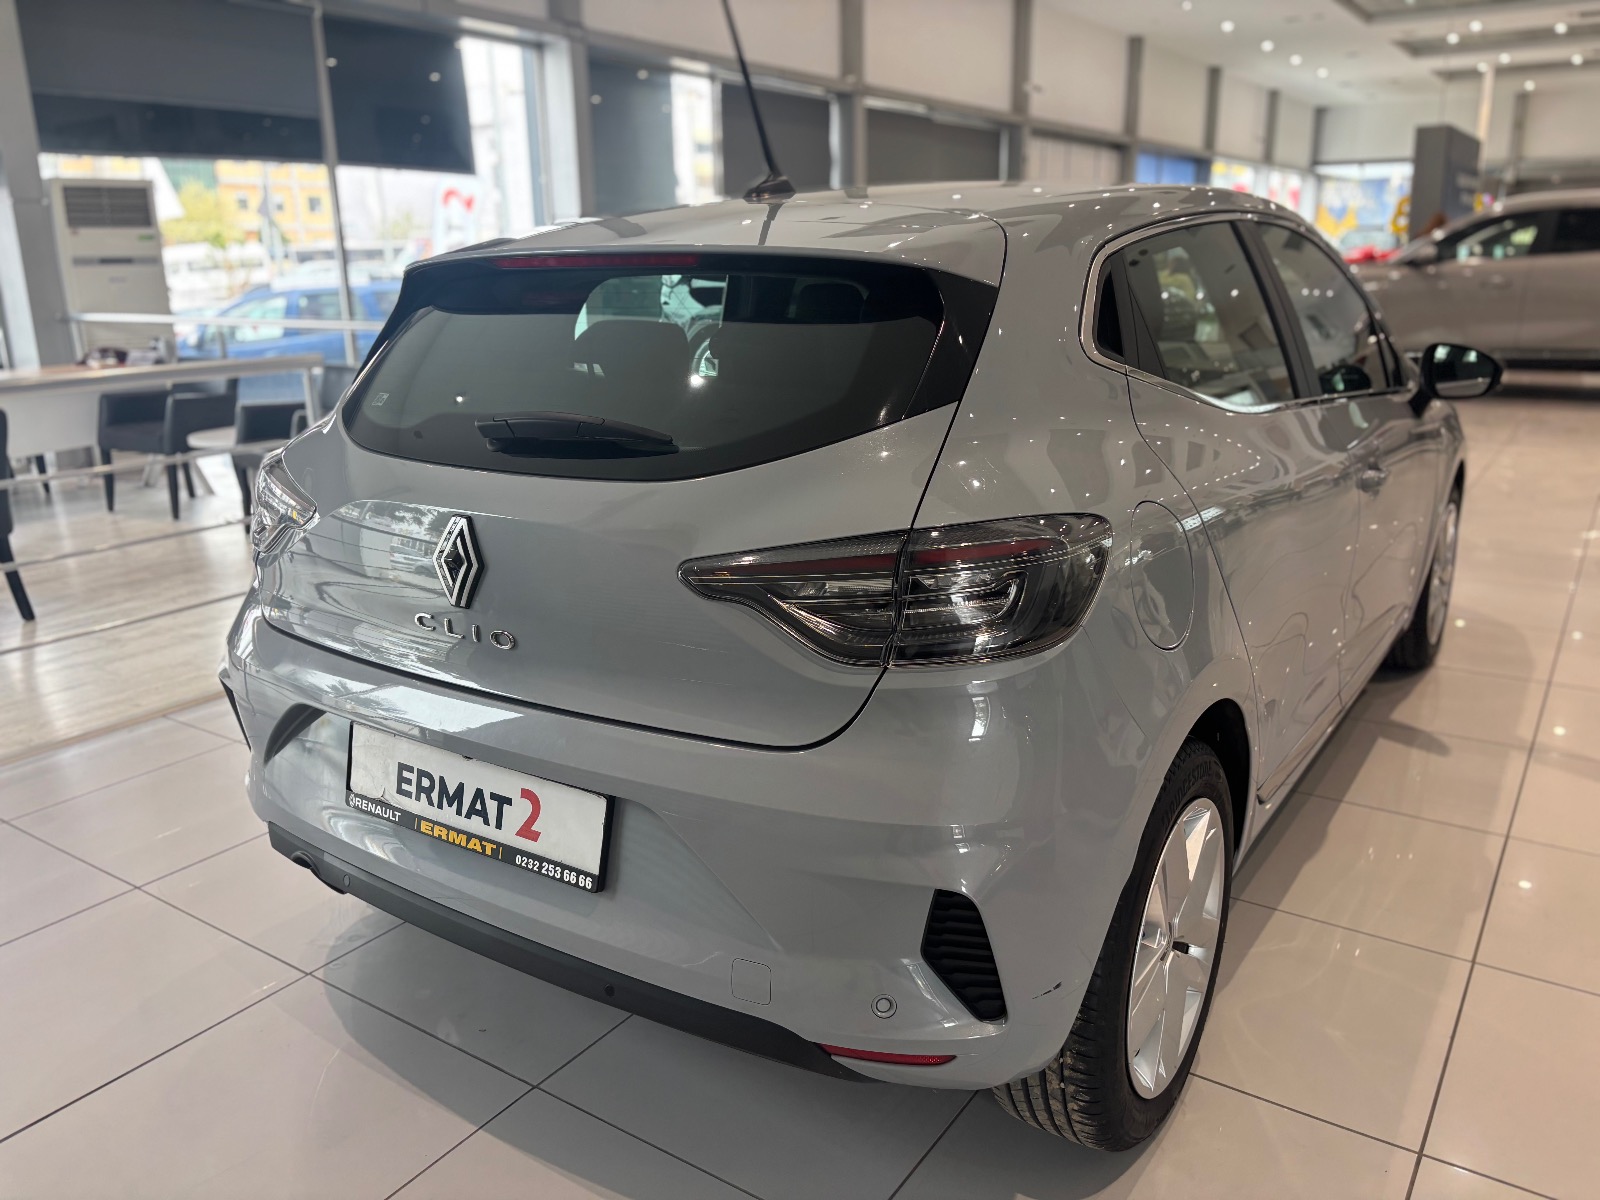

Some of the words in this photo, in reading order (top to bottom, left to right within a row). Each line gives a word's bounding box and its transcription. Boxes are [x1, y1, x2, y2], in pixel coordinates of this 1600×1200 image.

[414, 612, 516, 650] CLIO
[355, 797, 401, 822] RENAULT
[420, 820, 497, 856] ERMAT
[515, 854, 540, 872] 0232
[541, 861, 562, 879] 253
[563, 869, 577, 884] 66
[578, 874, 593, 889] 66
[396, 761, 513, 831] ERMAT
[515, 787, 542, 843] 2
